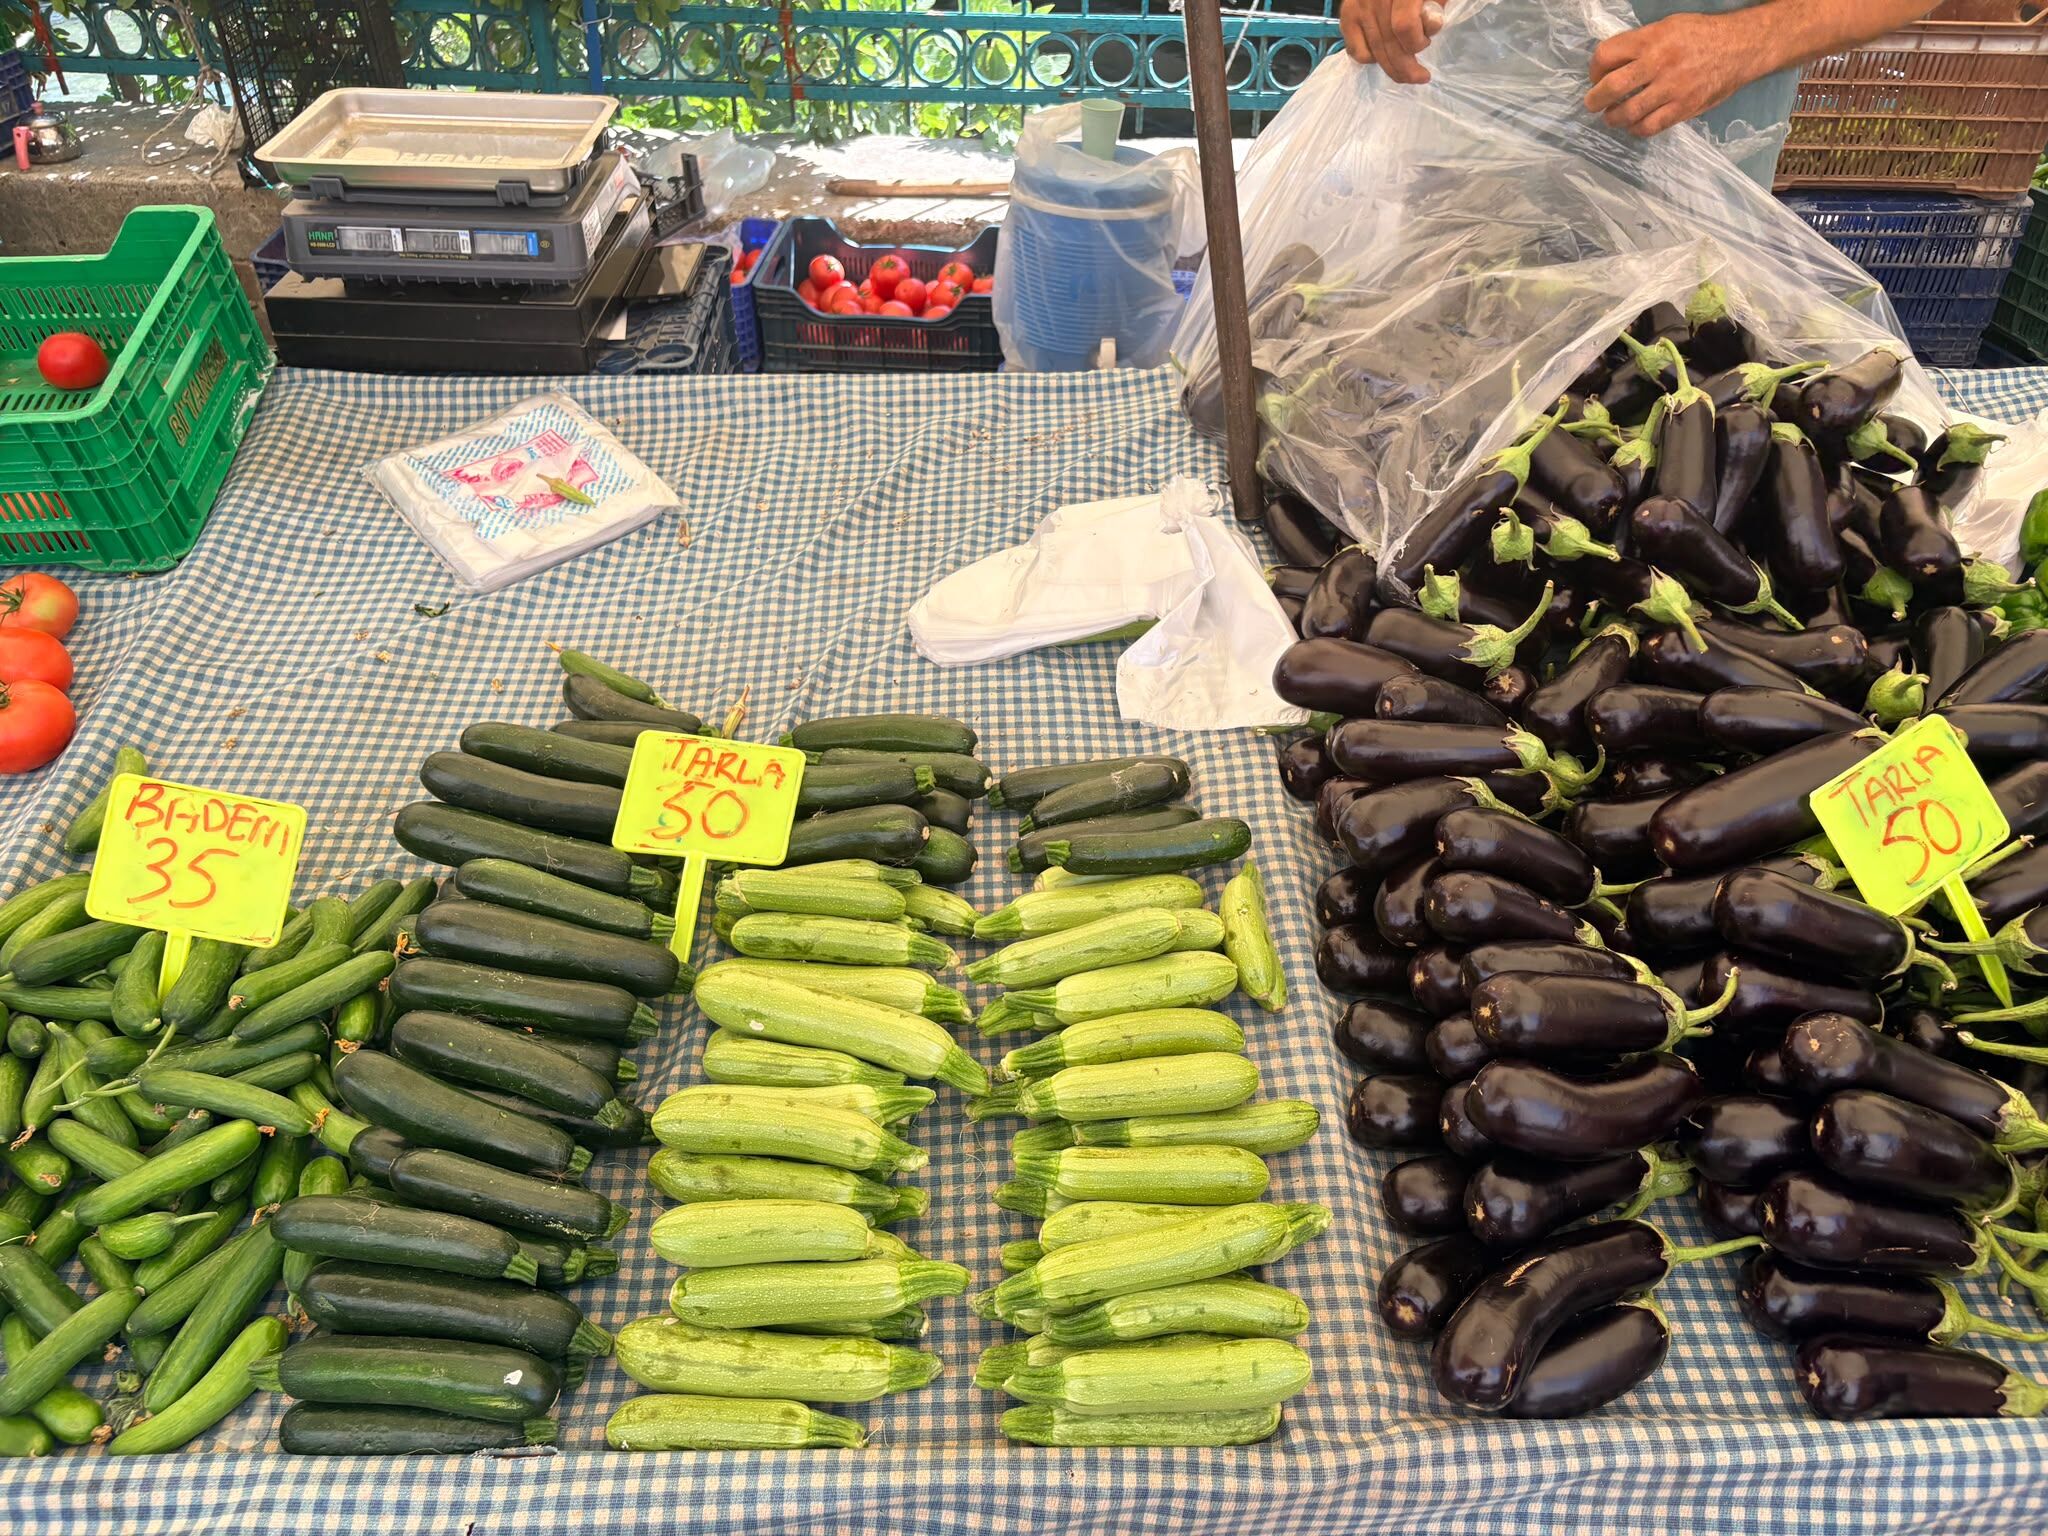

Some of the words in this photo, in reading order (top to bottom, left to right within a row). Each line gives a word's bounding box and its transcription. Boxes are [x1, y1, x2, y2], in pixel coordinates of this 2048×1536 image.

[308, 231, 335, 241] HANA
[665, 738, 786, 790] TARLA
[1828, 745, 1947, 829] TARLA
[124, 783, 290, 856] BADEM
[650, 779, 750, 840] 50
[1882, 799, 1963, 886] 50
[126, 837, 240, 909] 35
